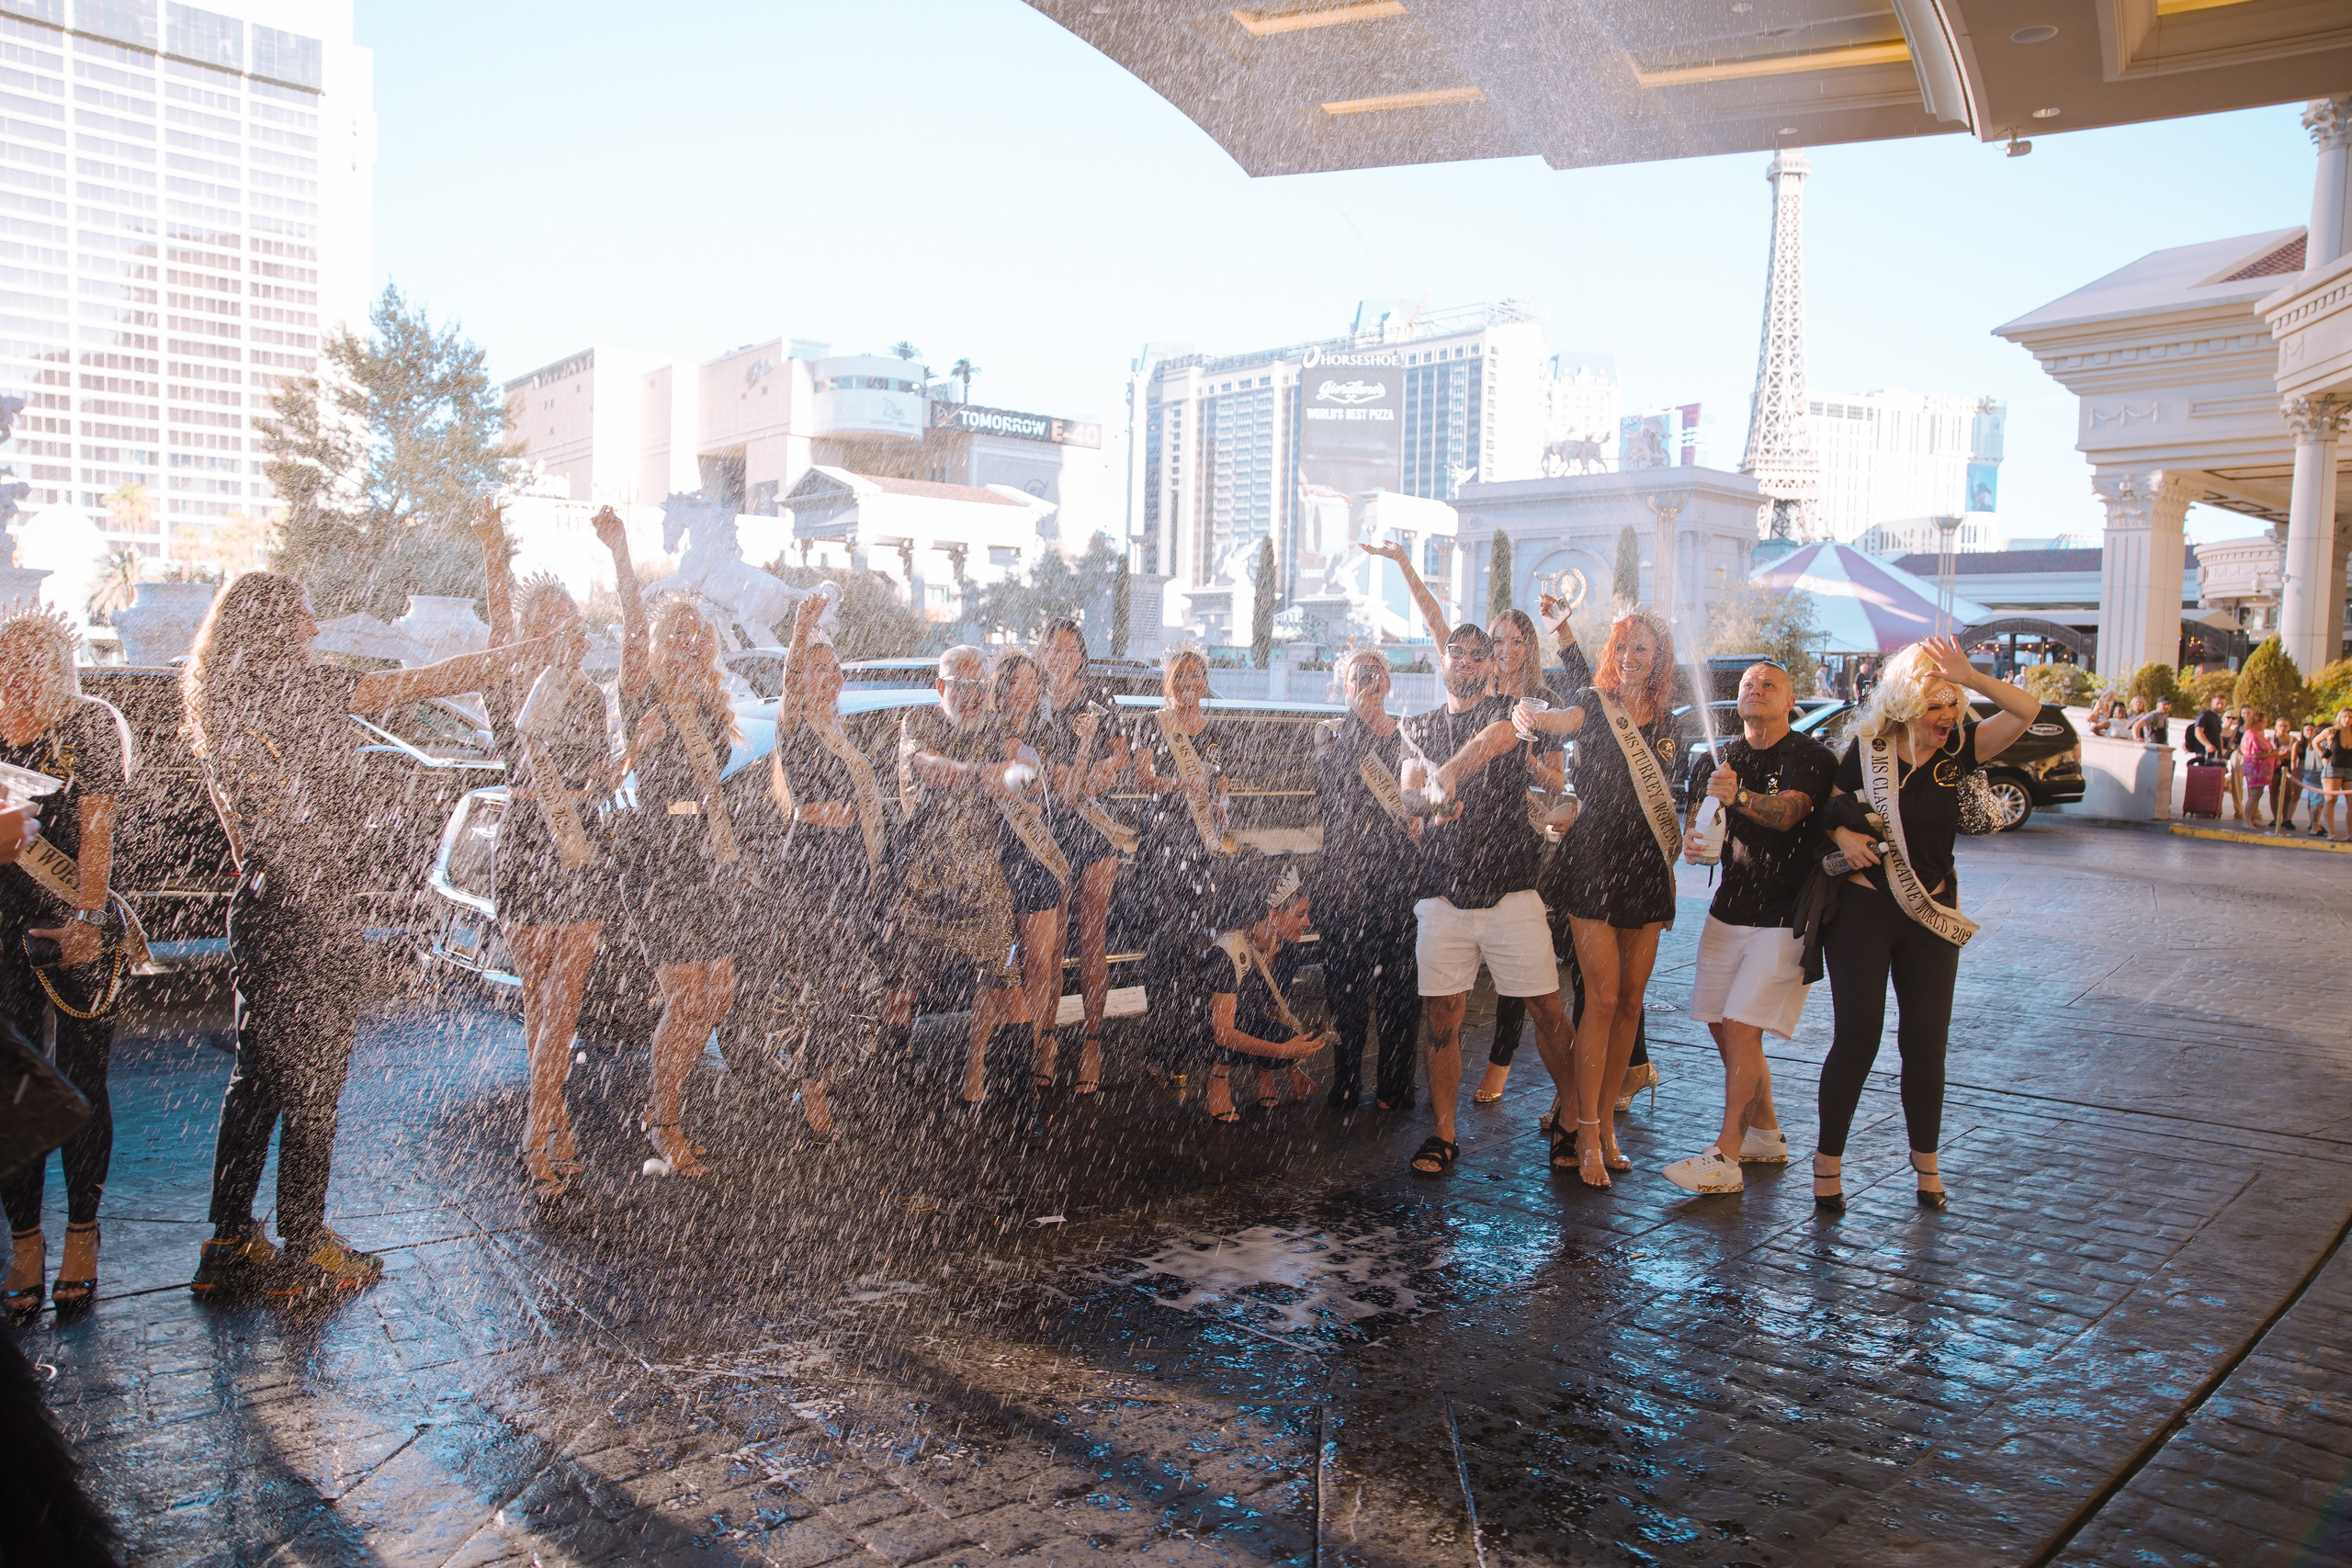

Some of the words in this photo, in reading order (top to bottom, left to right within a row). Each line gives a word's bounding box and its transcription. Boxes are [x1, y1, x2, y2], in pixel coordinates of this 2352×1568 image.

[1320, 354, 1398, 367] HORSESHOE
[960, 410, 1046, 436] TOMORROW
[1051, 419, 1100, 446] E-40
[1345, 409, 1368, 420] BEST
[1369, 409, 1395, 420] PIZZA
[1362, 756, 1392, 795] RUSSIA
[1622, 731, 1640, 750] MS
[1632, 748, 1664, 800] TURKEY
[1653, 801, 1678, 847] WORLD
[1871, 755, 1889, 773] MS
[1888, 838, 1923, 903] UKRAINE
[1914, 897, 1949, 935] WORLD
